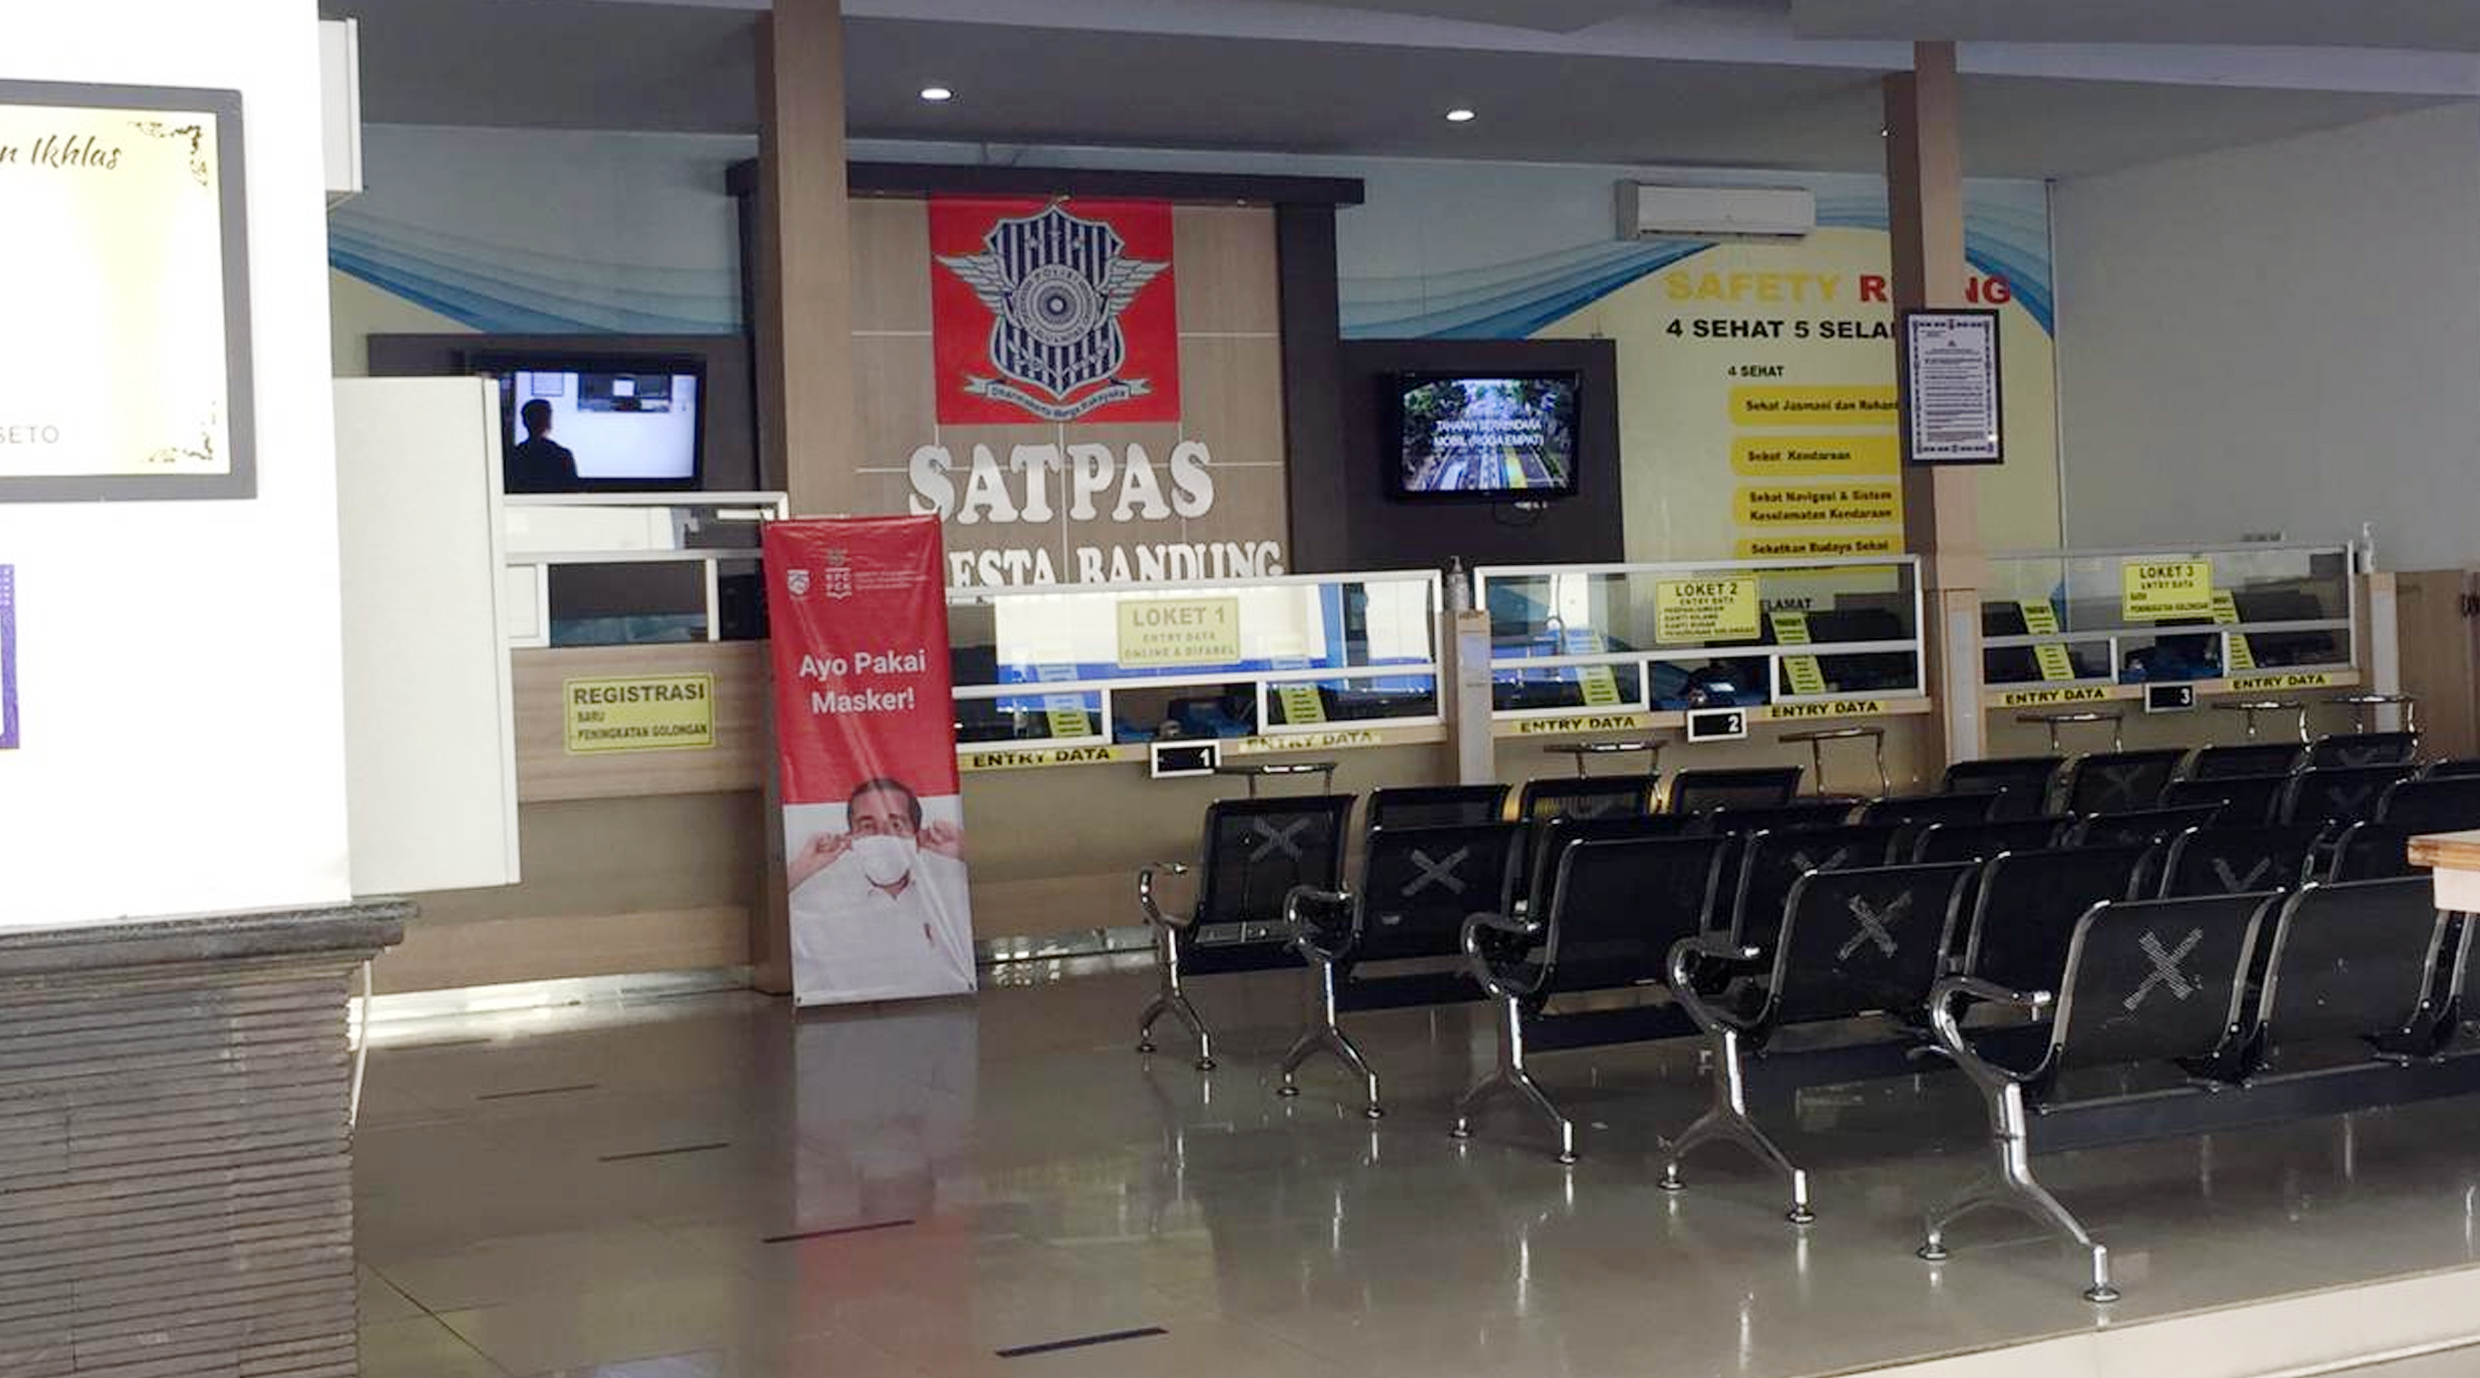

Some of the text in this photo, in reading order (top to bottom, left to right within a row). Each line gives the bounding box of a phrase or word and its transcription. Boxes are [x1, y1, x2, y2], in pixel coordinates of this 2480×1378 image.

[31, 135, 123, 170] Ikhlas
[1664, 270, 1842, 301] SAFETY
[1667, 318, 1897, 339] 4 SEHAT 5 SELA
[1727, 365, 1785, 377] 4 SEHAT
[908, 441, 1215, 525] SATPAS
[1077, 541, 1286, 586] BANDUNG
[2139, 565, 2195, 580] LOKET 3
[1674, 582, 1738, 597] LOKET 2
[1679, 598, 1710, 606] ENTRY
[1132, 603, 1225, 627] LOKET 1
[1142, 631, 1216, 643] ENTRY DATA
[799, 649, 926, 682] Ayo Pakai
[2233, 674, 2326, 690] ENTRY DATA
[573, 683, 705, 705] REGISTRASI
[811, 686, 915, 715] Masker!
[2005, 687, 2105, 705] ENTRY DATA
[2180, 688, 2191, 704] 3
[577, 711, 605, 723] BARU
[1771, 701, 1879, 718] ENTRY DATA
[577, 724, 708, 740] PENINGKATAN GOLONGAN
[1520, 716, 1636, 734] ENTRY DATA
[1728, 716, 1740, 732] 2
[1247, 731, 1374, 750] ENTRY DATA
[973, 748, 1111, 768] ENTRY DATA
[1200, 748, 1211, 767] 1
